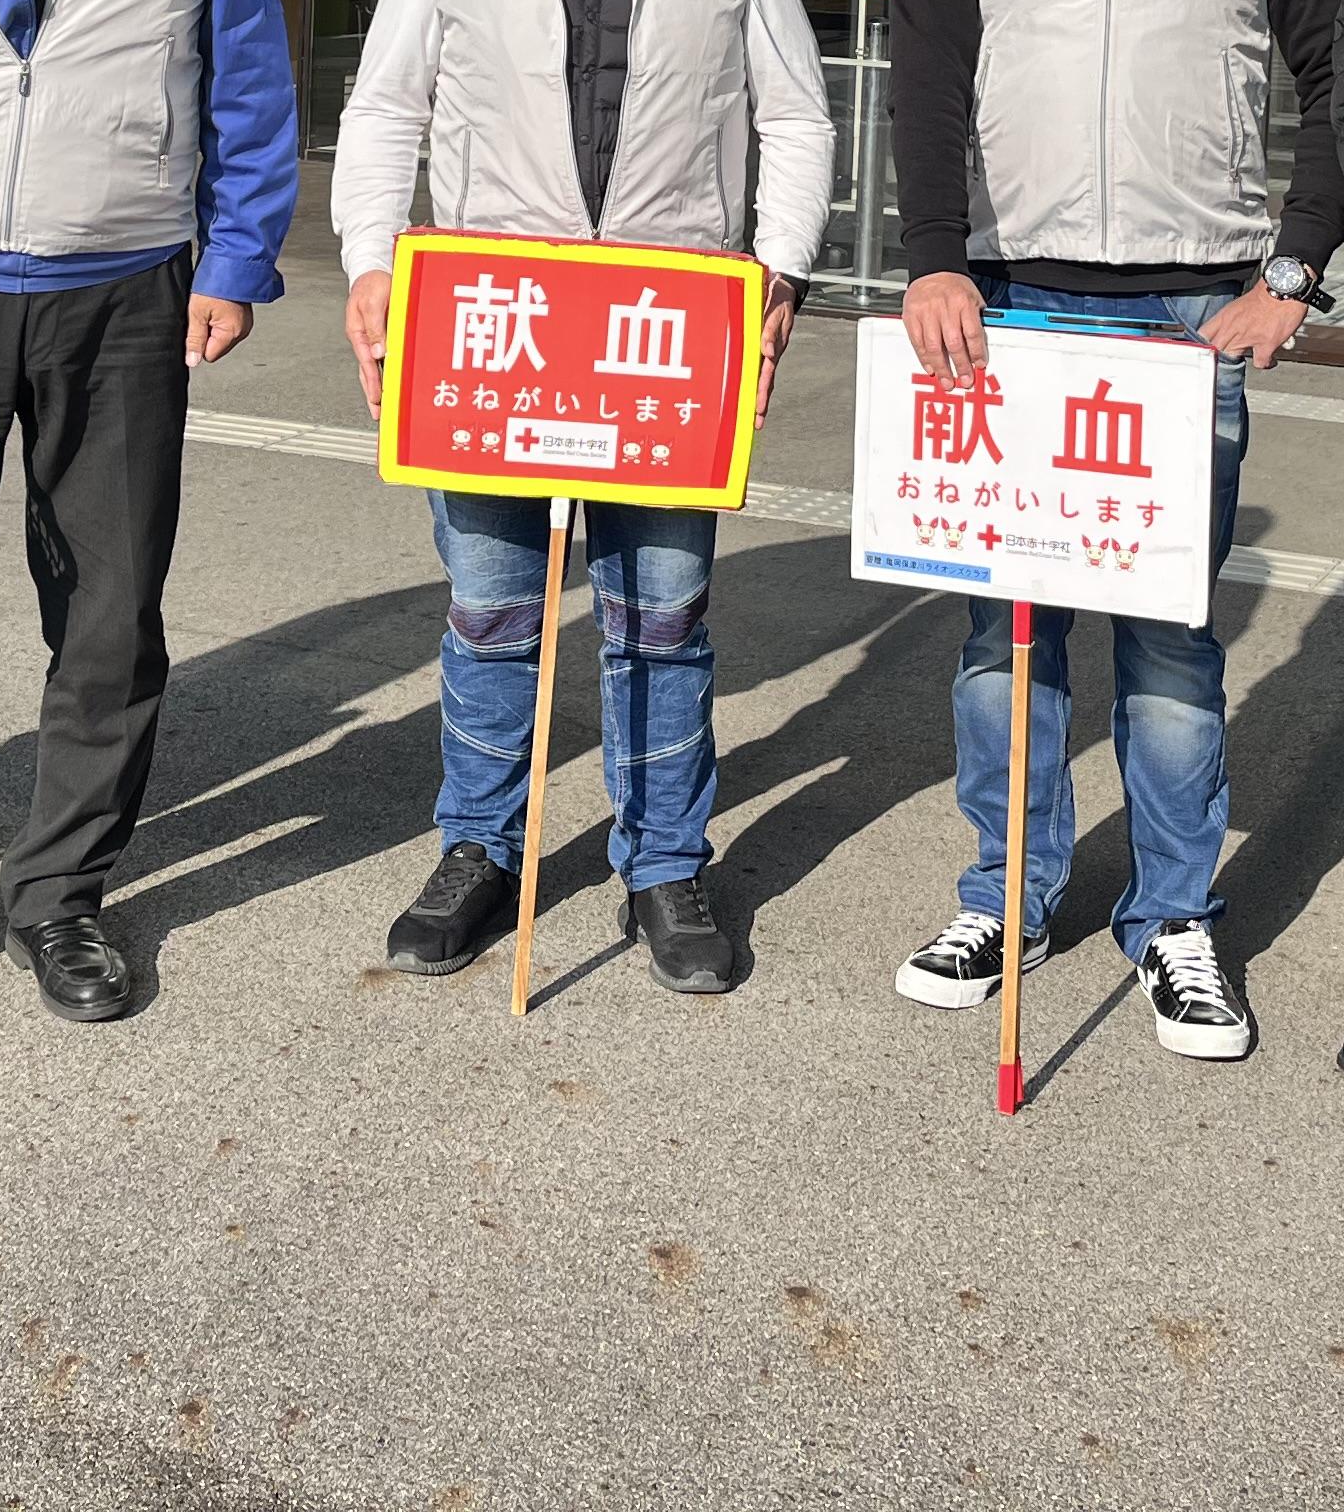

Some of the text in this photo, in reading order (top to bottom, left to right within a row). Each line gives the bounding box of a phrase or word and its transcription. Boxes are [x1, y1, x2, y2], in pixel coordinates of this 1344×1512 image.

[451, 273, 692, 380] 献血
[432, 379, 701, 426] おねがいします
[911, 367, 1152, 479] 献血
[543, 435, 608, 452] 日本赤十字社
[896, 471, 1164, 529] おねがいします
[1005, 533, 1071, 554] 日本赤十字社
